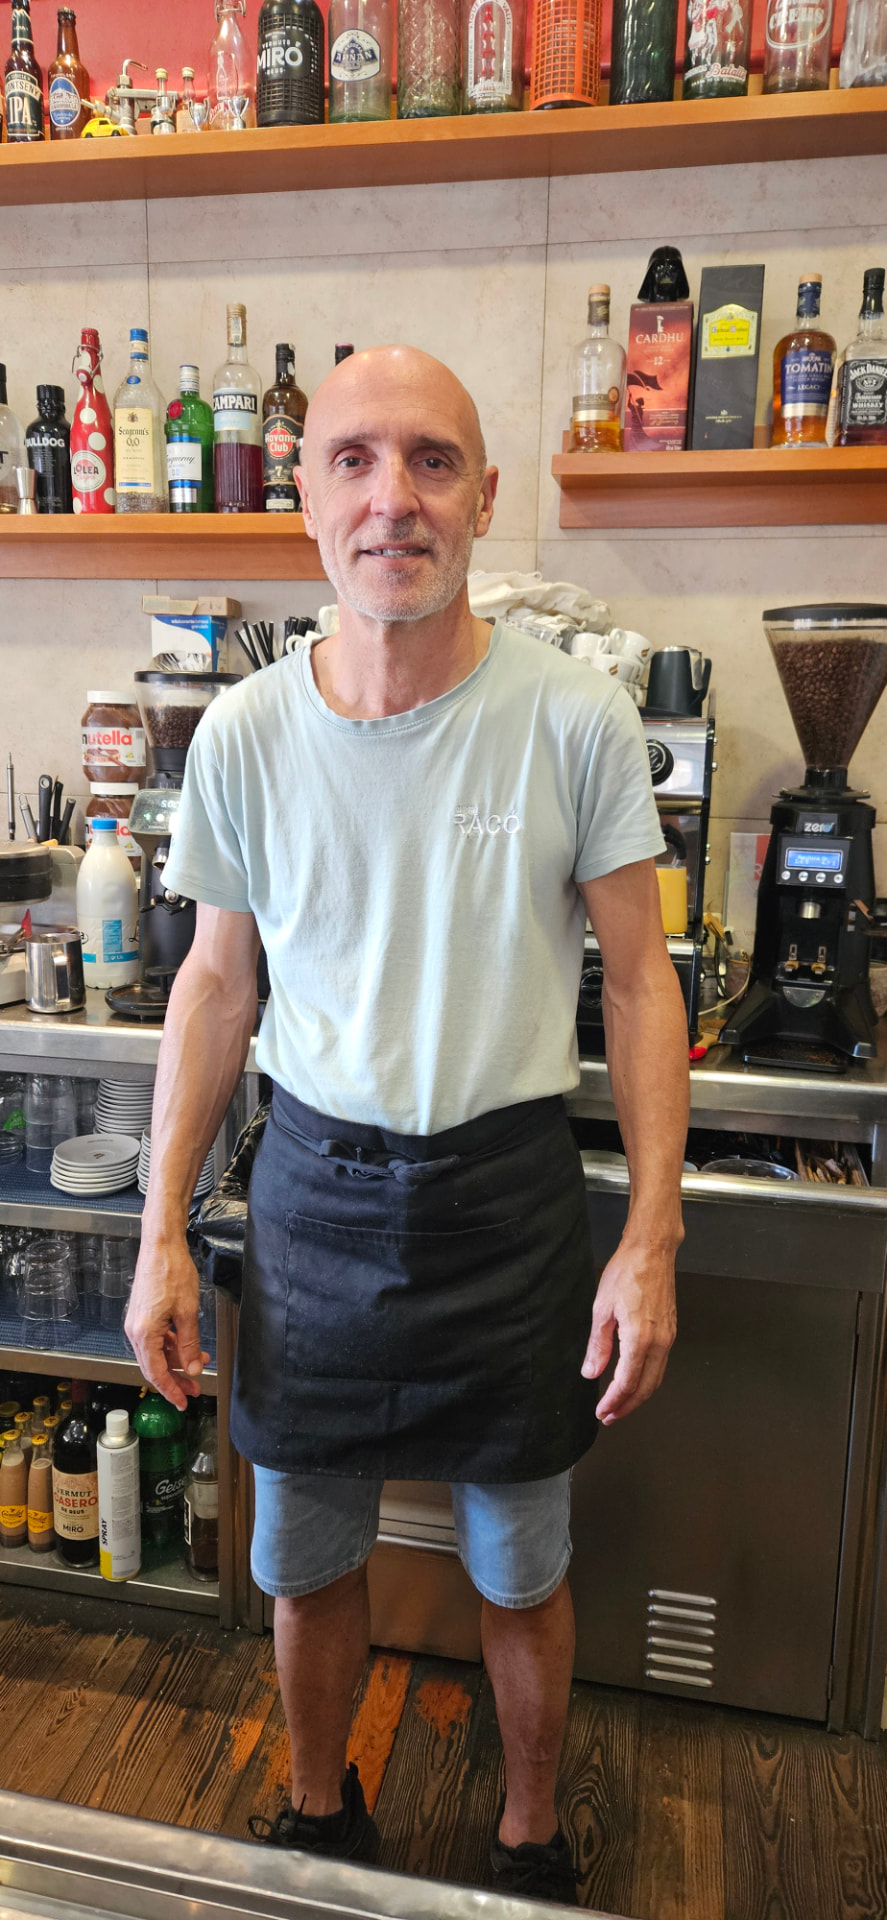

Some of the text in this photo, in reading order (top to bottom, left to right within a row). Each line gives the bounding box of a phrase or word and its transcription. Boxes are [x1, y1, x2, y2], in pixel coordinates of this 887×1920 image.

[7, 97, 33, 126] IPA
[635, 332, 684, 344] CARDHU
[785, 362, 832, 375] TOMATIN
[850, 366, 866, 380] JACK
[270, 440, 289, 452] Club
[74, 464, 99, 475] LOLEA
[82, 730, 132, 745] nutella
[804, 822, 834, 833] zero
[57, 1487, 91, 1498] VERMUT
[100, 1518, 108, 1546] SPRAY
